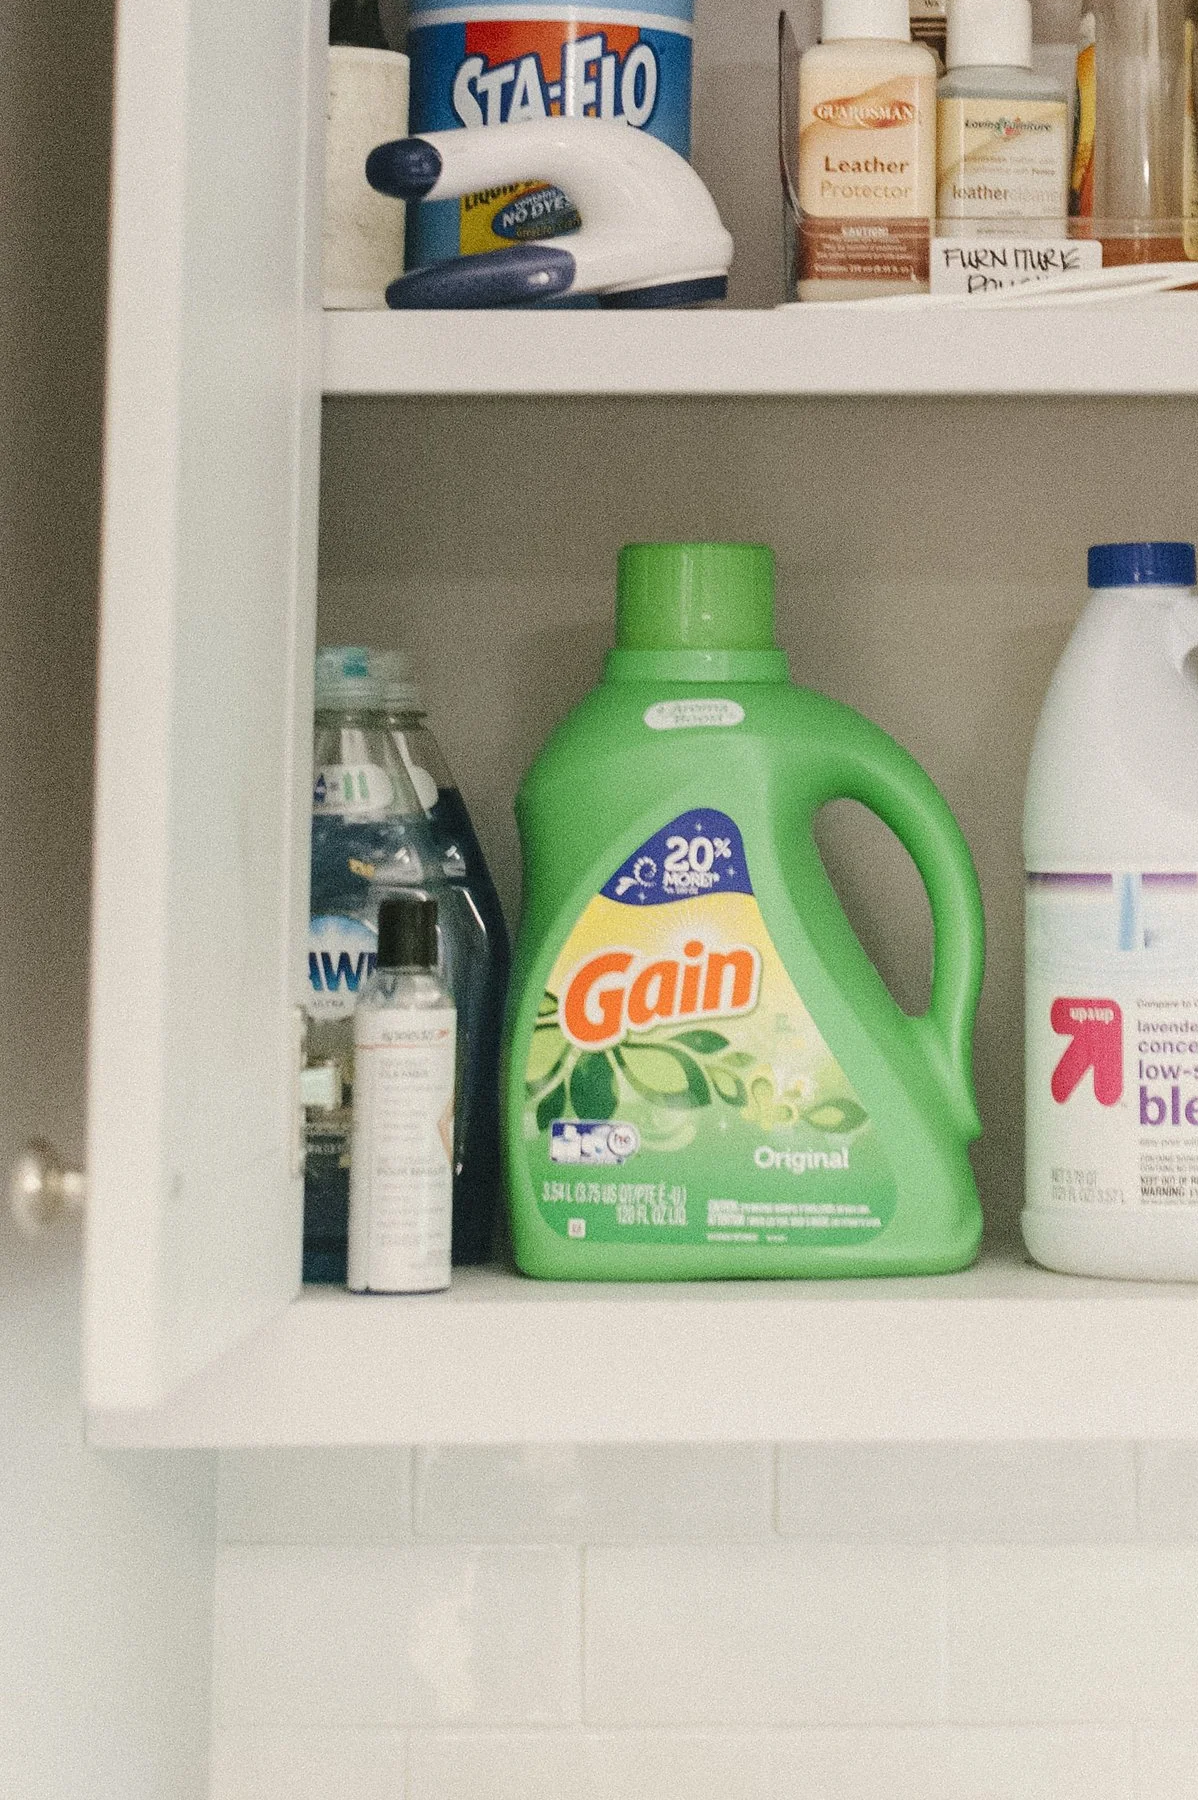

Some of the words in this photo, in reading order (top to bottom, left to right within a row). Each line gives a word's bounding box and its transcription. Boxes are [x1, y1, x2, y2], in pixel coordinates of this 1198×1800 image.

[452, 34, 658, 130] STA-FLO
[816, 104, 914, 127] GUARDSMAN
[824, 156, 910, 175] Leather
[820, 181, 912, 200] Protector
[951, 185, 1010, 201] leather
[502, 208, 528, 229] NO
[530, 194, 571, 219] DYES
[942, 246, 1081, 272] FURNITURE
[663, 836, 732, 873] 20%
[564, 940, 756, 1044] Gain
[753, 1145, 850, 1176] Original
